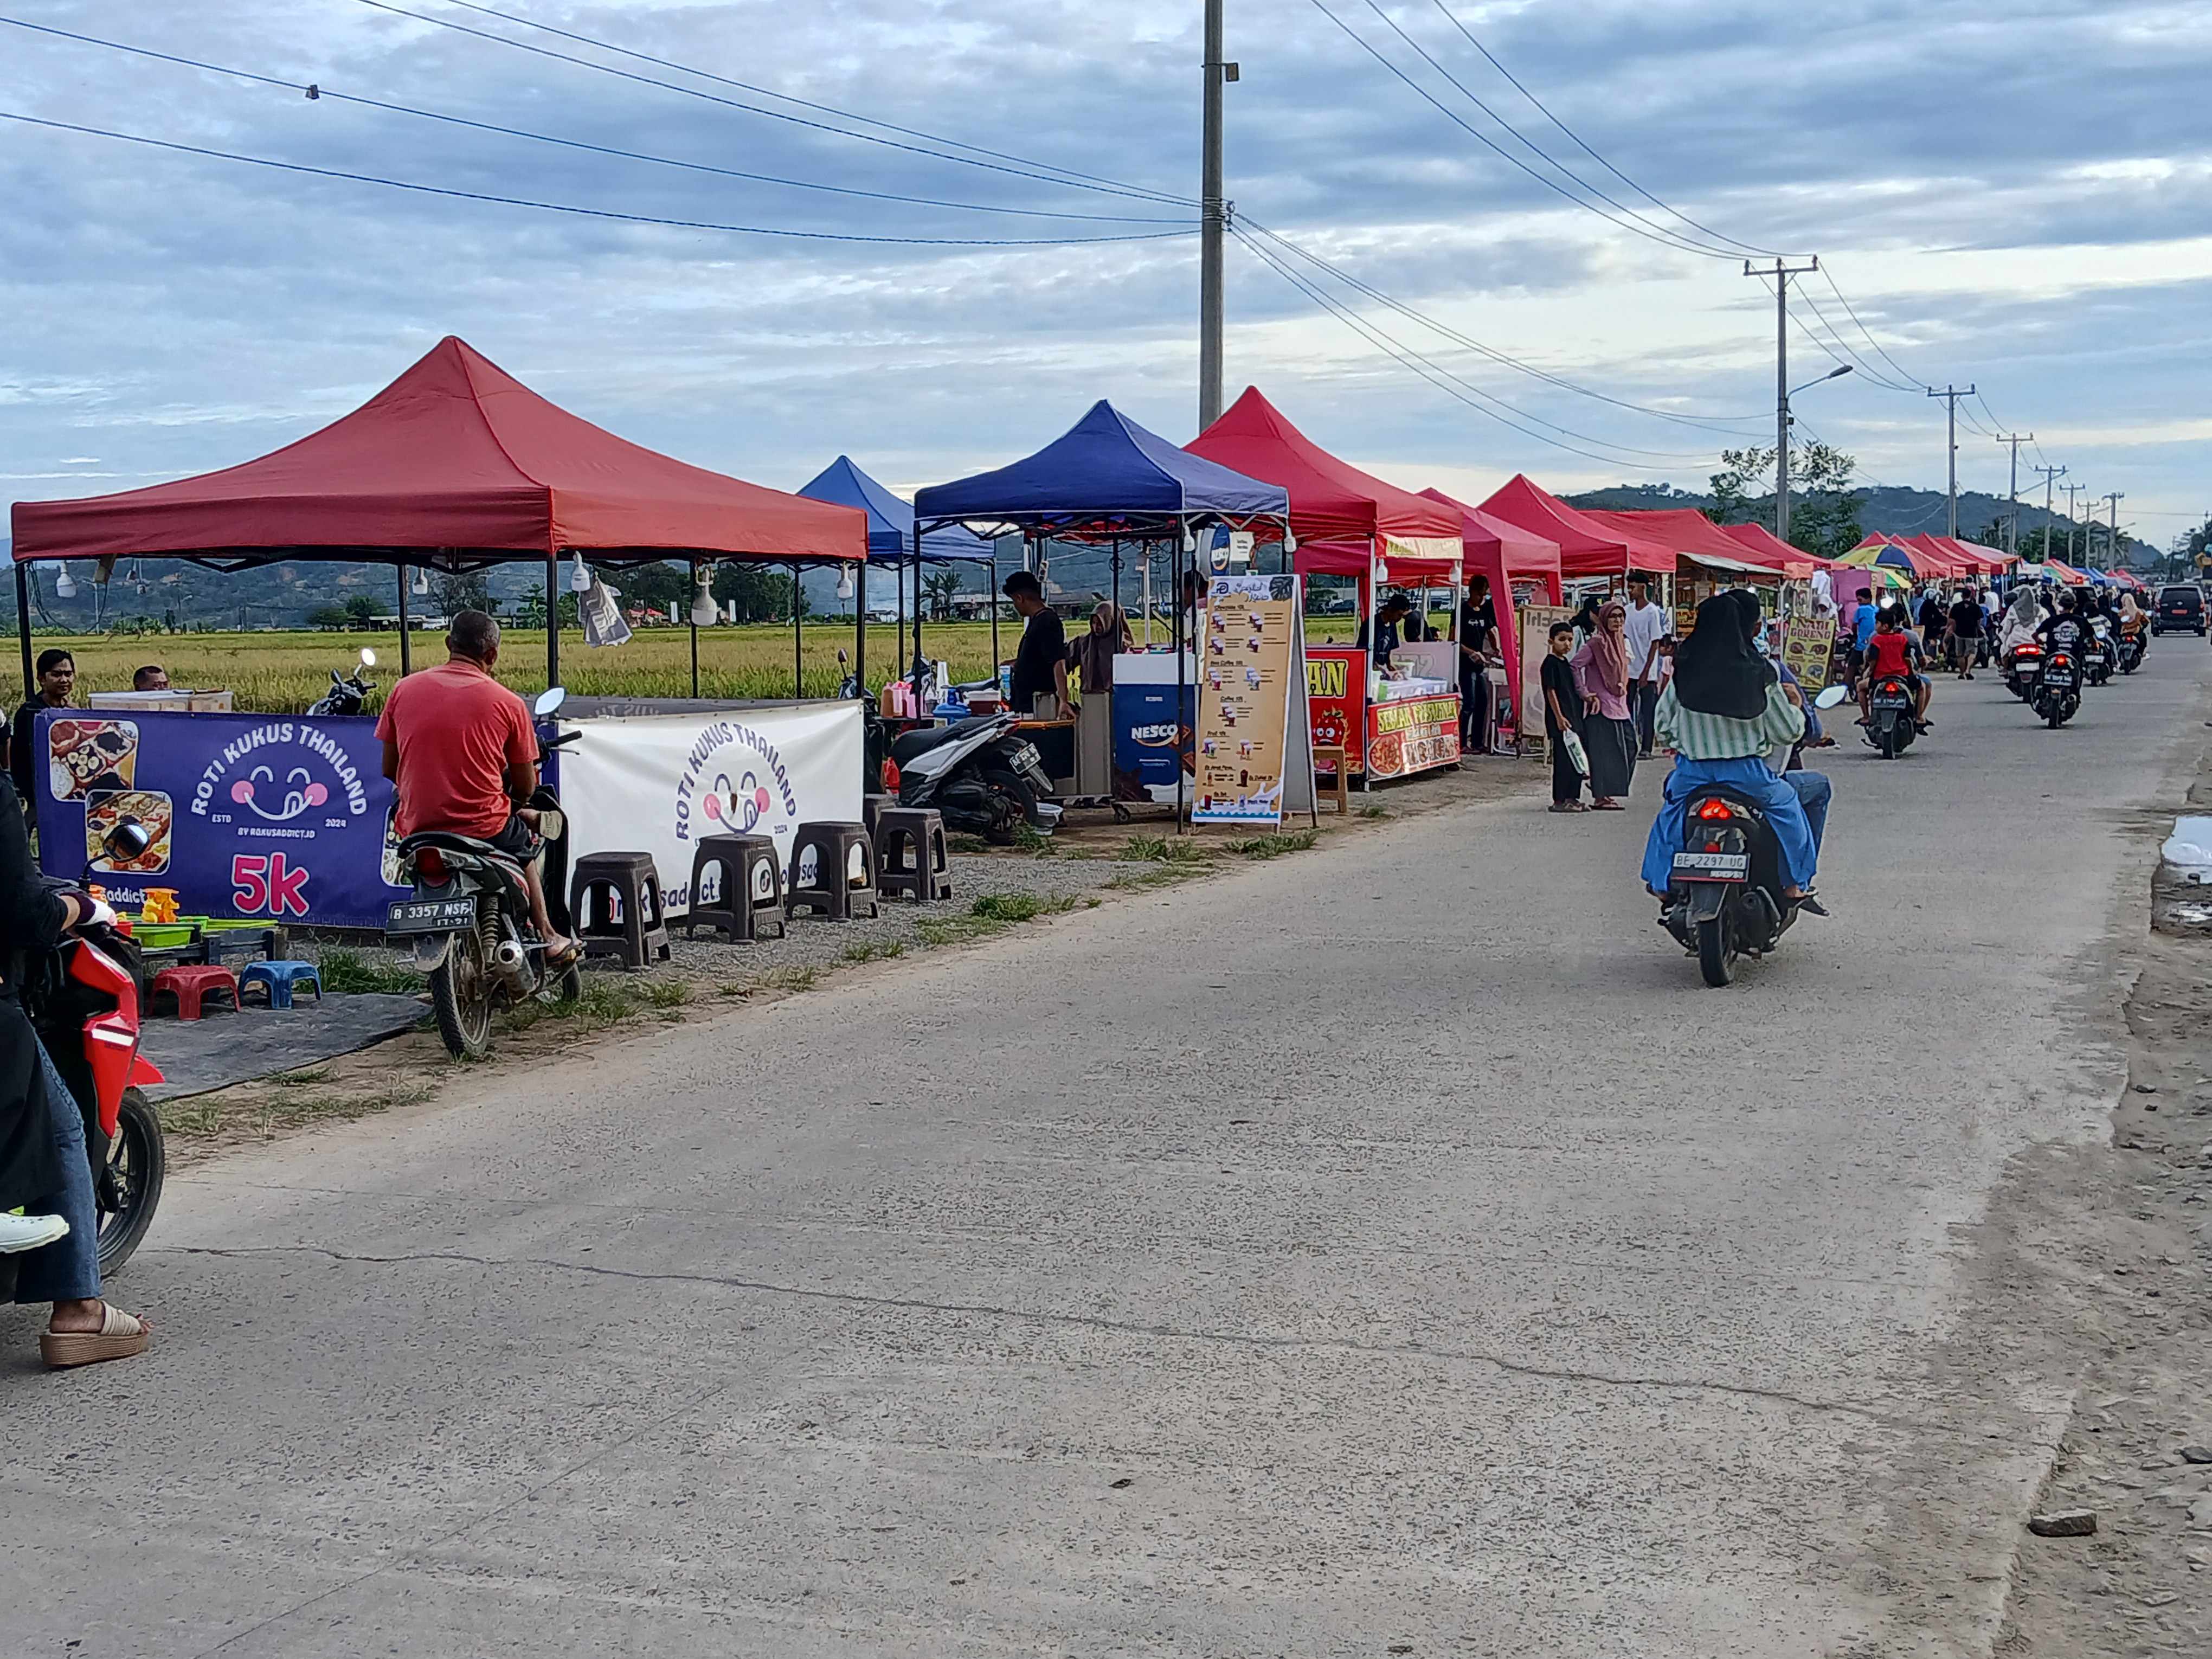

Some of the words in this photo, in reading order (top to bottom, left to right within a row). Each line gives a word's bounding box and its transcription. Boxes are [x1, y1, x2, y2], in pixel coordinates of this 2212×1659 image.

[191, 760, 225, 815] ROTI
[223, 723, 294, 764] KUKUS
[298, 724, 367, 815] THAILAND
[676, 771, 695, 840] ROTI
[688, 722, 733, 774] KUKUS
[733, 723, 796, 816] THAILAND
[211, 814, 232, 823] ESTD
[325, 818, 346, 827] 2024
[237, 827, 248, 836] BY
[1676, 855, 1690, 866] BE
[1695, 856, 1724, 866] 2297
[231, 852, 310, 917] 5k
[104, 886, 146, 904] addict
[393, 909, 402, 919] B
[408, 904, 439, 918] 3357
